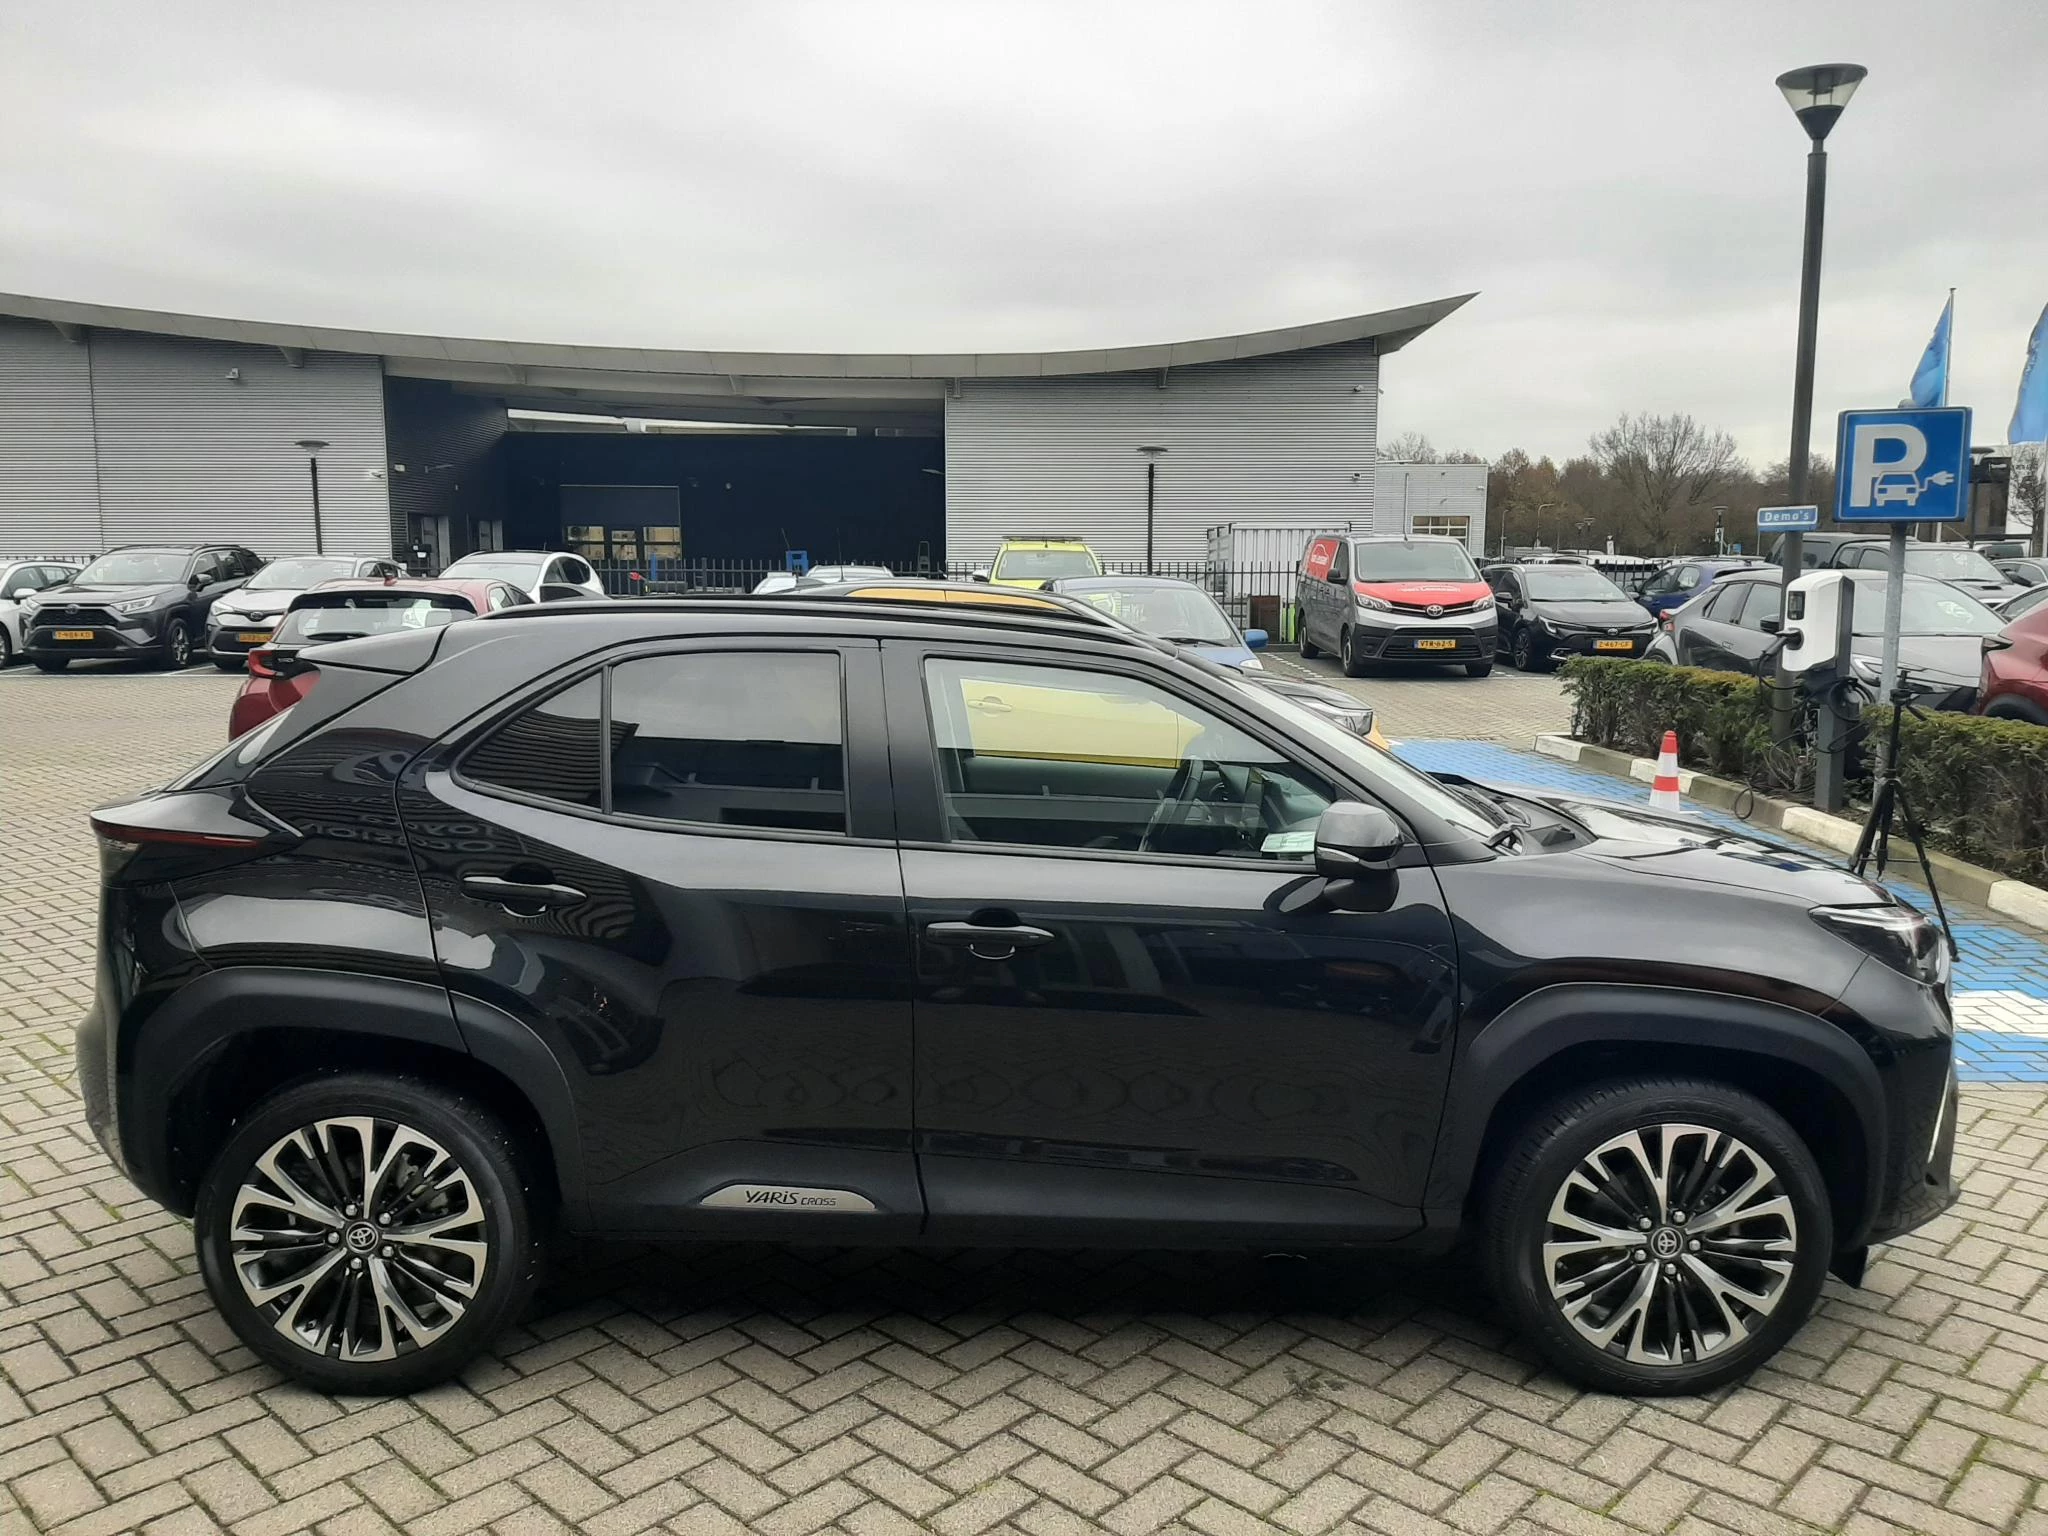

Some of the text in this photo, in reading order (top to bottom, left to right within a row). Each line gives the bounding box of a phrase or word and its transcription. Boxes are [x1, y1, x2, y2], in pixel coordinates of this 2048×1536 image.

[1850, 424, 1927, 507] P
[1764, 510, 1809, 521] Demo's
[800, 1197, 836, 1206] CROSS
